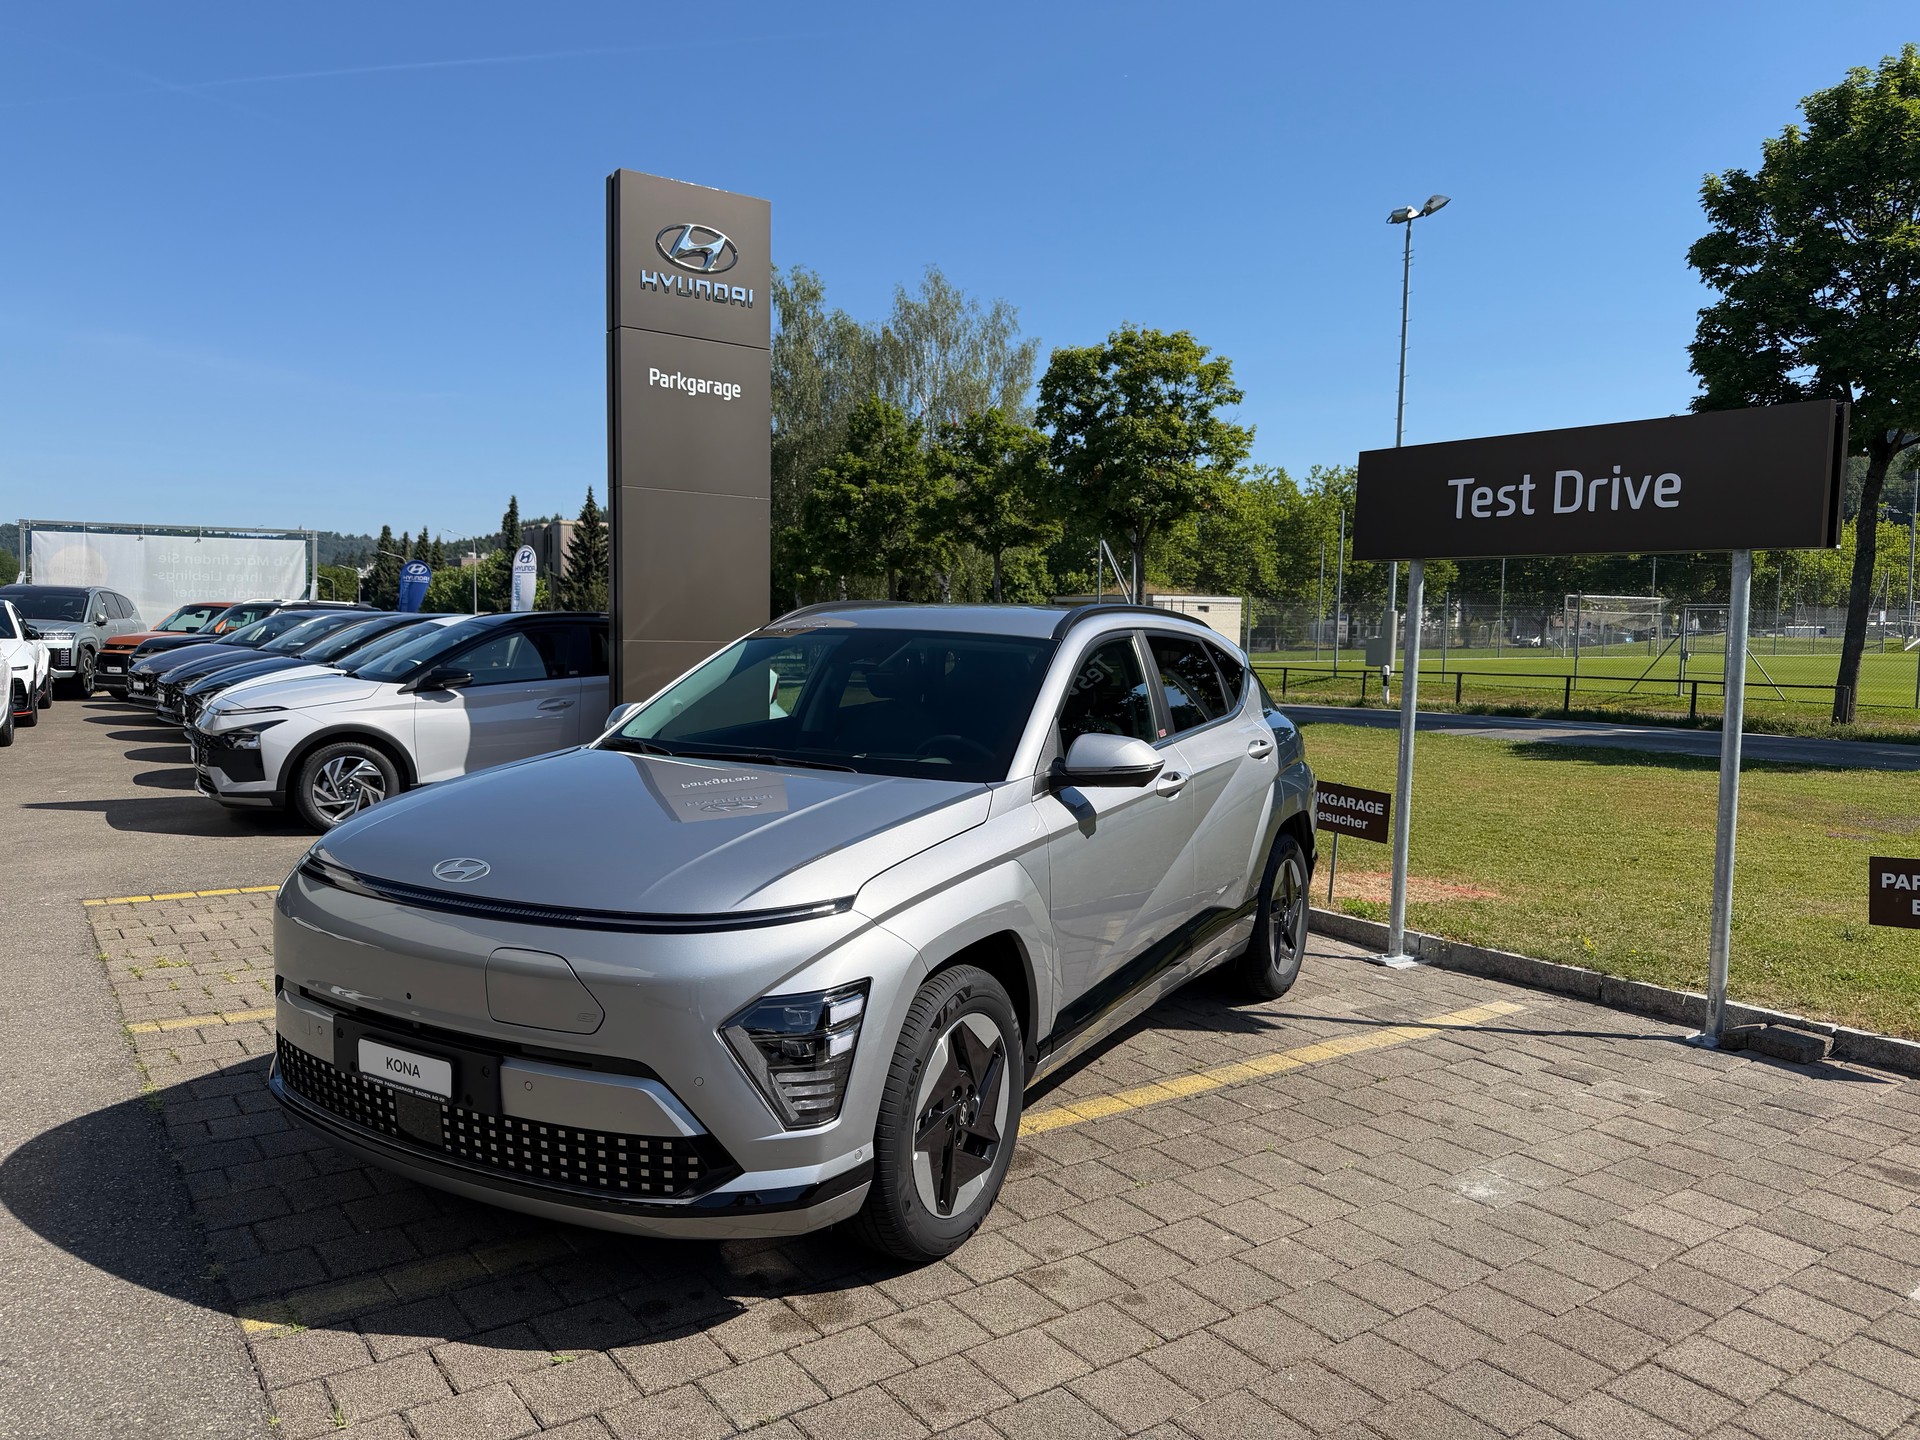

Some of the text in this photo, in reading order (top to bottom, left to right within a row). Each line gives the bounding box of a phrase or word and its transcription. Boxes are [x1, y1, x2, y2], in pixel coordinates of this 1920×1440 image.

[640, 269, 754, 309] HYUNDAI
[649, 367, 742, 401] Parkgarage
[1447, 464, 1683, 519] Test Drive
[1316, 810, 1369, 829] esucher
[386, 1056, 421, 1078] KONA
[901, 1058, 923, 1132] NEXEN
